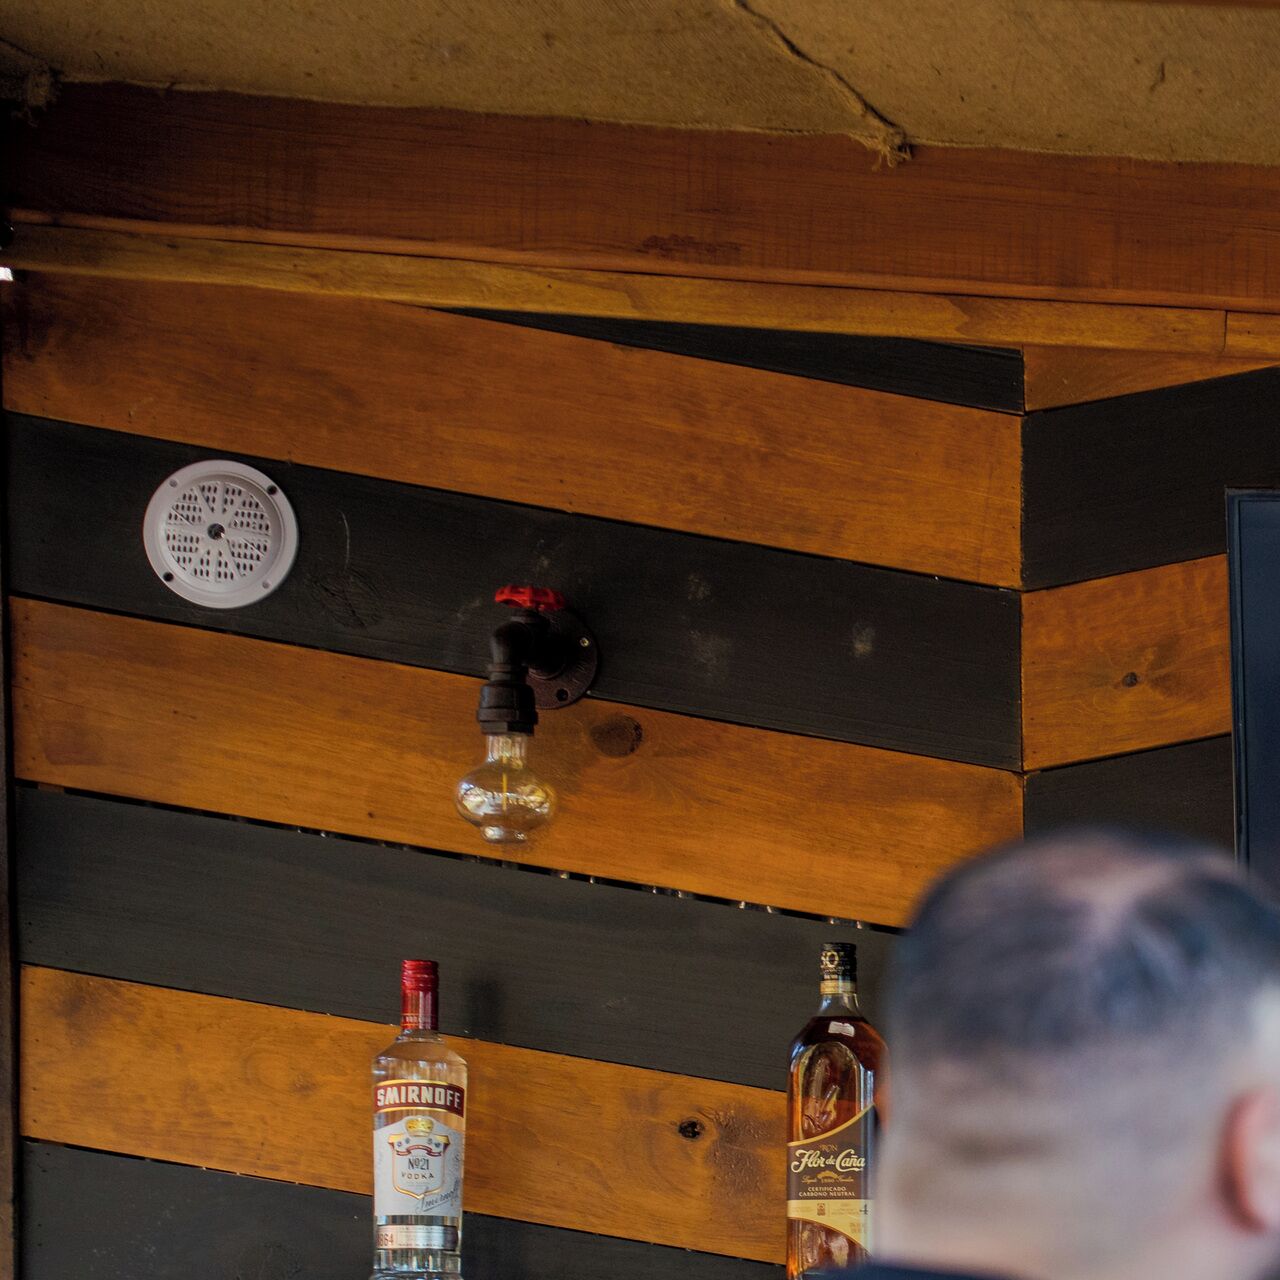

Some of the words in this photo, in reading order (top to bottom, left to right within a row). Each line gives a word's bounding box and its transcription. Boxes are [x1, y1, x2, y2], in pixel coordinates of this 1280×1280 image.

[377, 1085, 461, 1109] SMIRNOFF
[791, 1149, 825, 1173] Flor
[825, 1155, 836, 1165] de
[835, 1148, 866, 1172] Caña
[401, 1172, 435, 1180] VODKA
